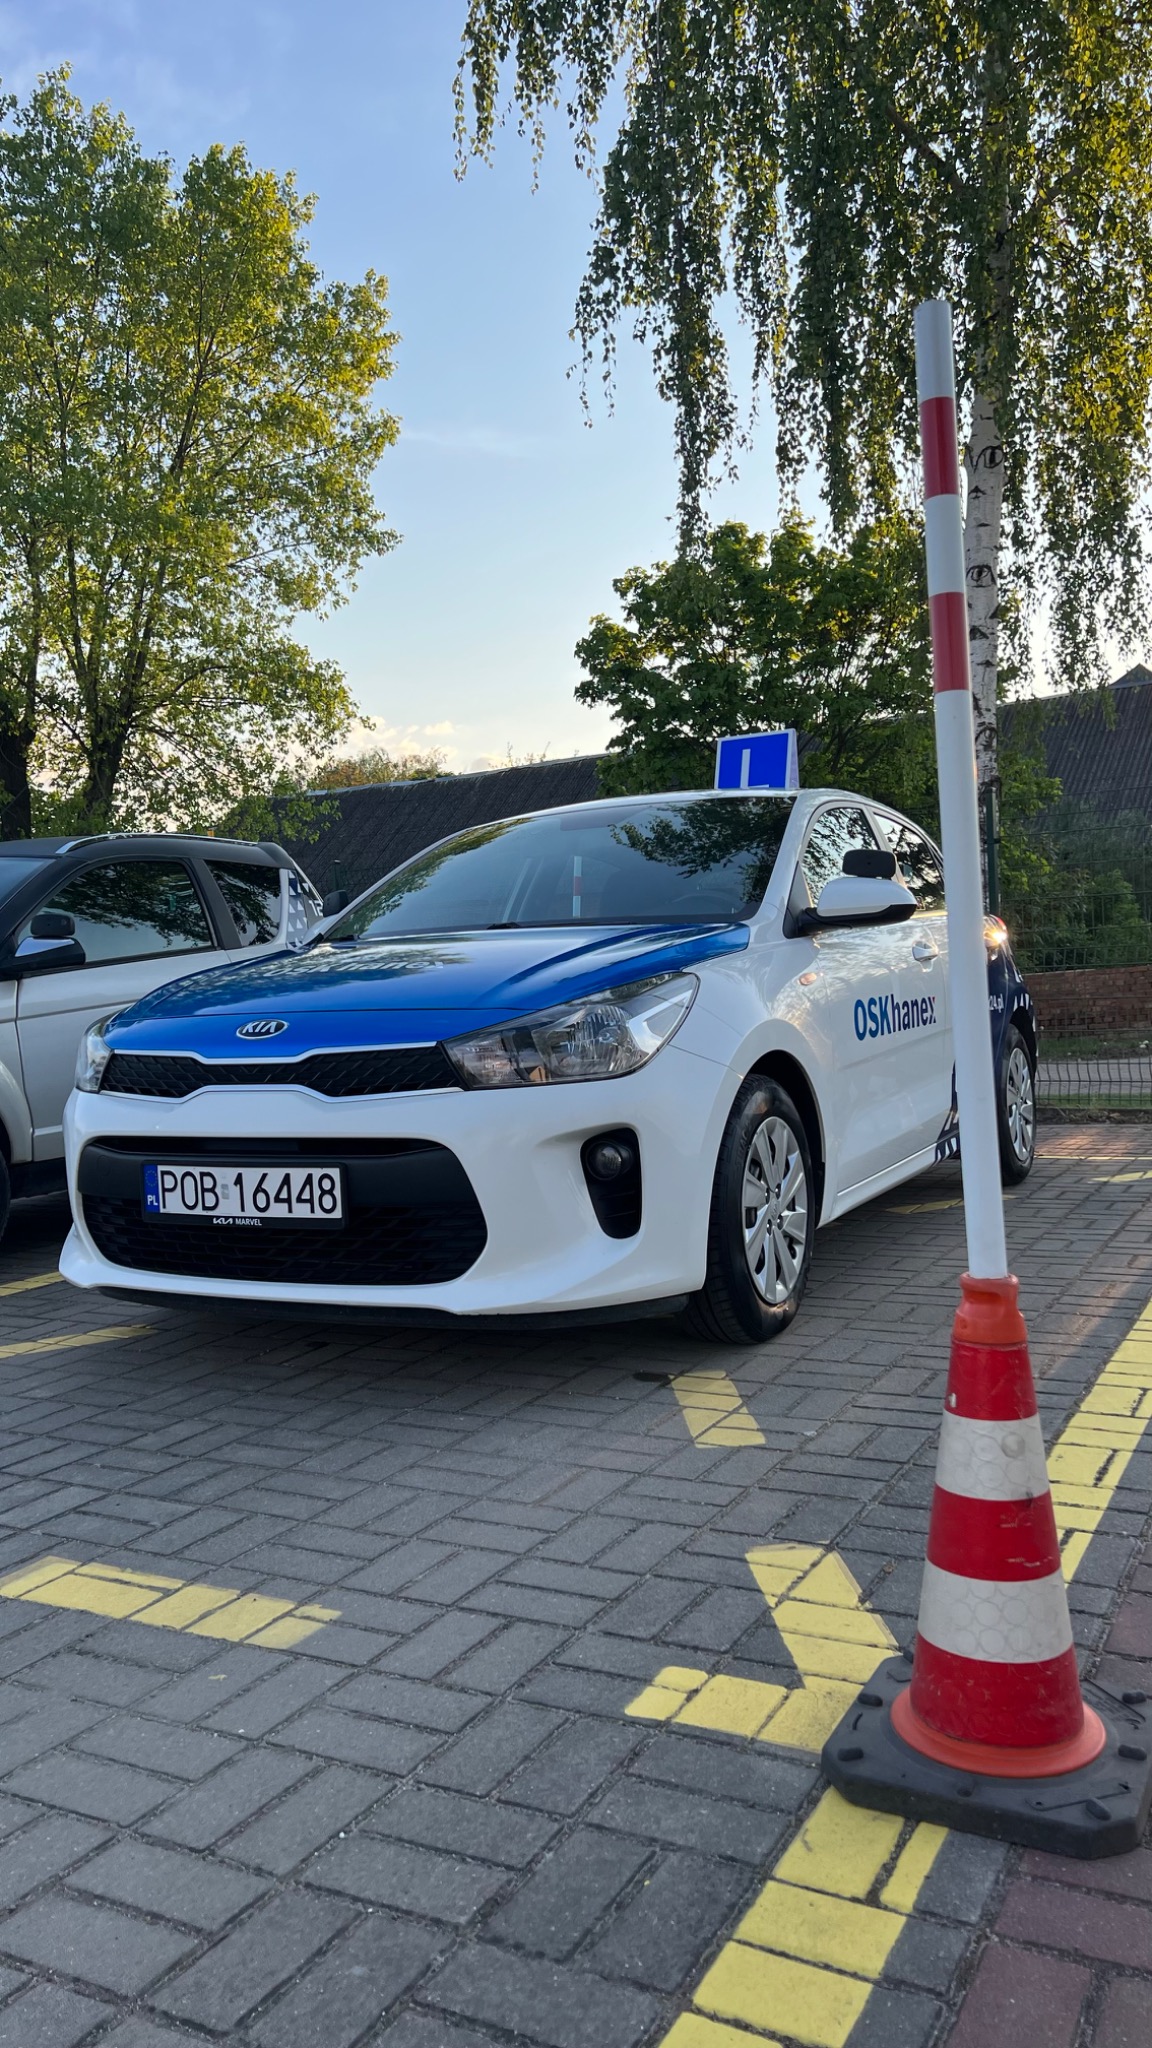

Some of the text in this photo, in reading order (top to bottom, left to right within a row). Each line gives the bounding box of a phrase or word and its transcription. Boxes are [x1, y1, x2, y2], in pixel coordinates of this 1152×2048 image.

[740, 748, 769, 789] L
[241, 1021, 278, 1034] KIA
[160, 1170, 337, 1214] POB 16448
[147, 1195, 158, 1206] PL
[235, 1218, 262, 1226] MARVEL
